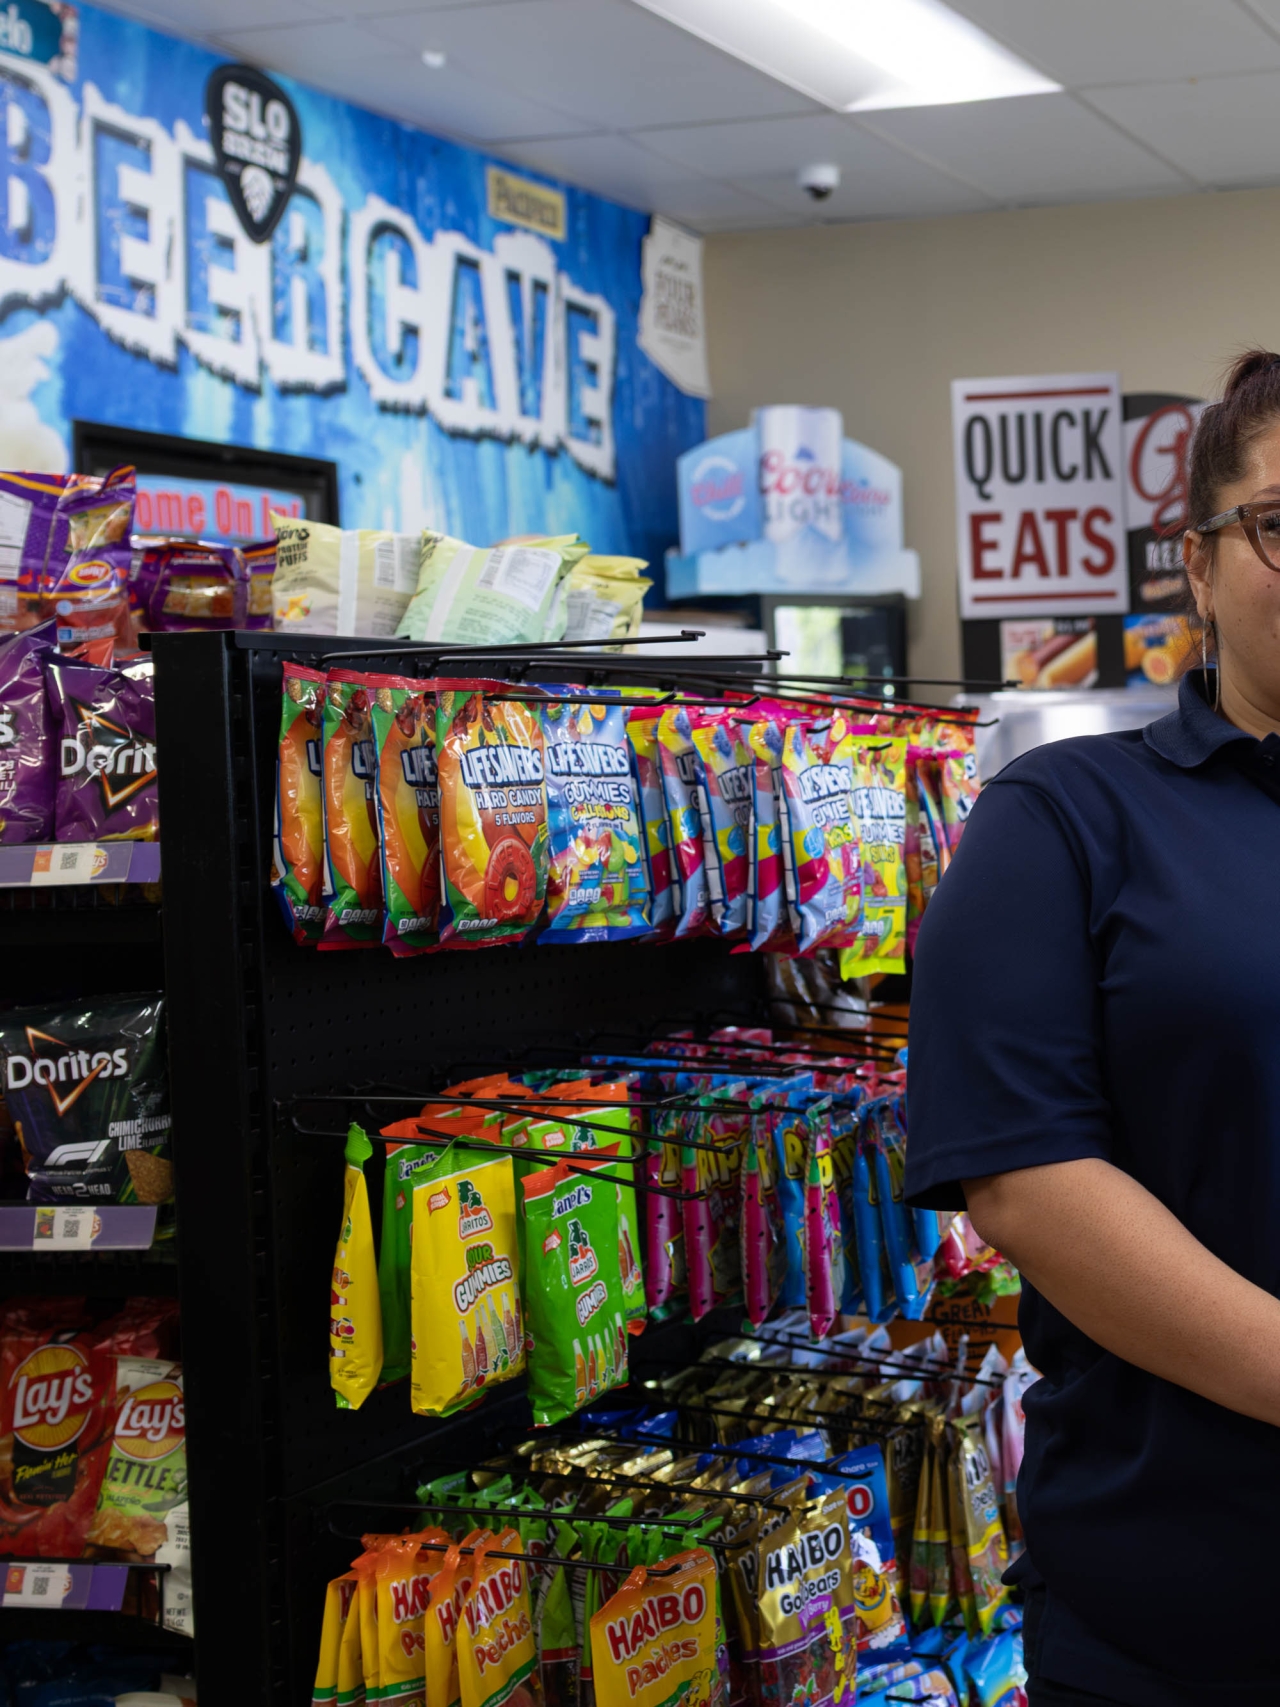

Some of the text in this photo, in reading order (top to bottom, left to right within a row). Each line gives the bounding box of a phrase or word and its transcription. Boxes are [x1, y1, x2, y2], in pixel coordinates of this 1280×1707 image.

[222, 80, 290, 141] SLO
[0, 60, 616, 484] BEER CAVE
[965, 408, 1113, 500] QUICK
[136, 488, 206, 534] ome
[214, 485, 252, 536] On
[279, 553, 308, 568] PUFFS
[970, 508, 1116, 580] EATS
[61, 738, 157, 776] Dorit
[415, 789, 438, 809] HAR
[476, 787, 543, 809] HARD CANDY
[564, 781, 631, 804] GUMMIES
[495, 811, 536, 826] 5 FLAVORS
[7, 1048, 127, 1089] Doritos
[118, 1134, 142, 1152] LIME
[454, 1260, 512, 1312] GUMMIES
[572, 1256, 594, 1278] JARROS
[931, 1301, 992, 1324] GREAT
[13, 1366, 92, 1429] Lay's
[115, 1396, 185, 1442] Lay's
[104, 1457, 170, 1492] ETTLE
[841, 1462, 865, 1474] Share
[390, 1573, 432, 1624] HAR
[473, 1611, 531, 1677] Peches
[605, 1582, 705, 1664] HARIBO
[626, 1638, 699, 1699] Paches
